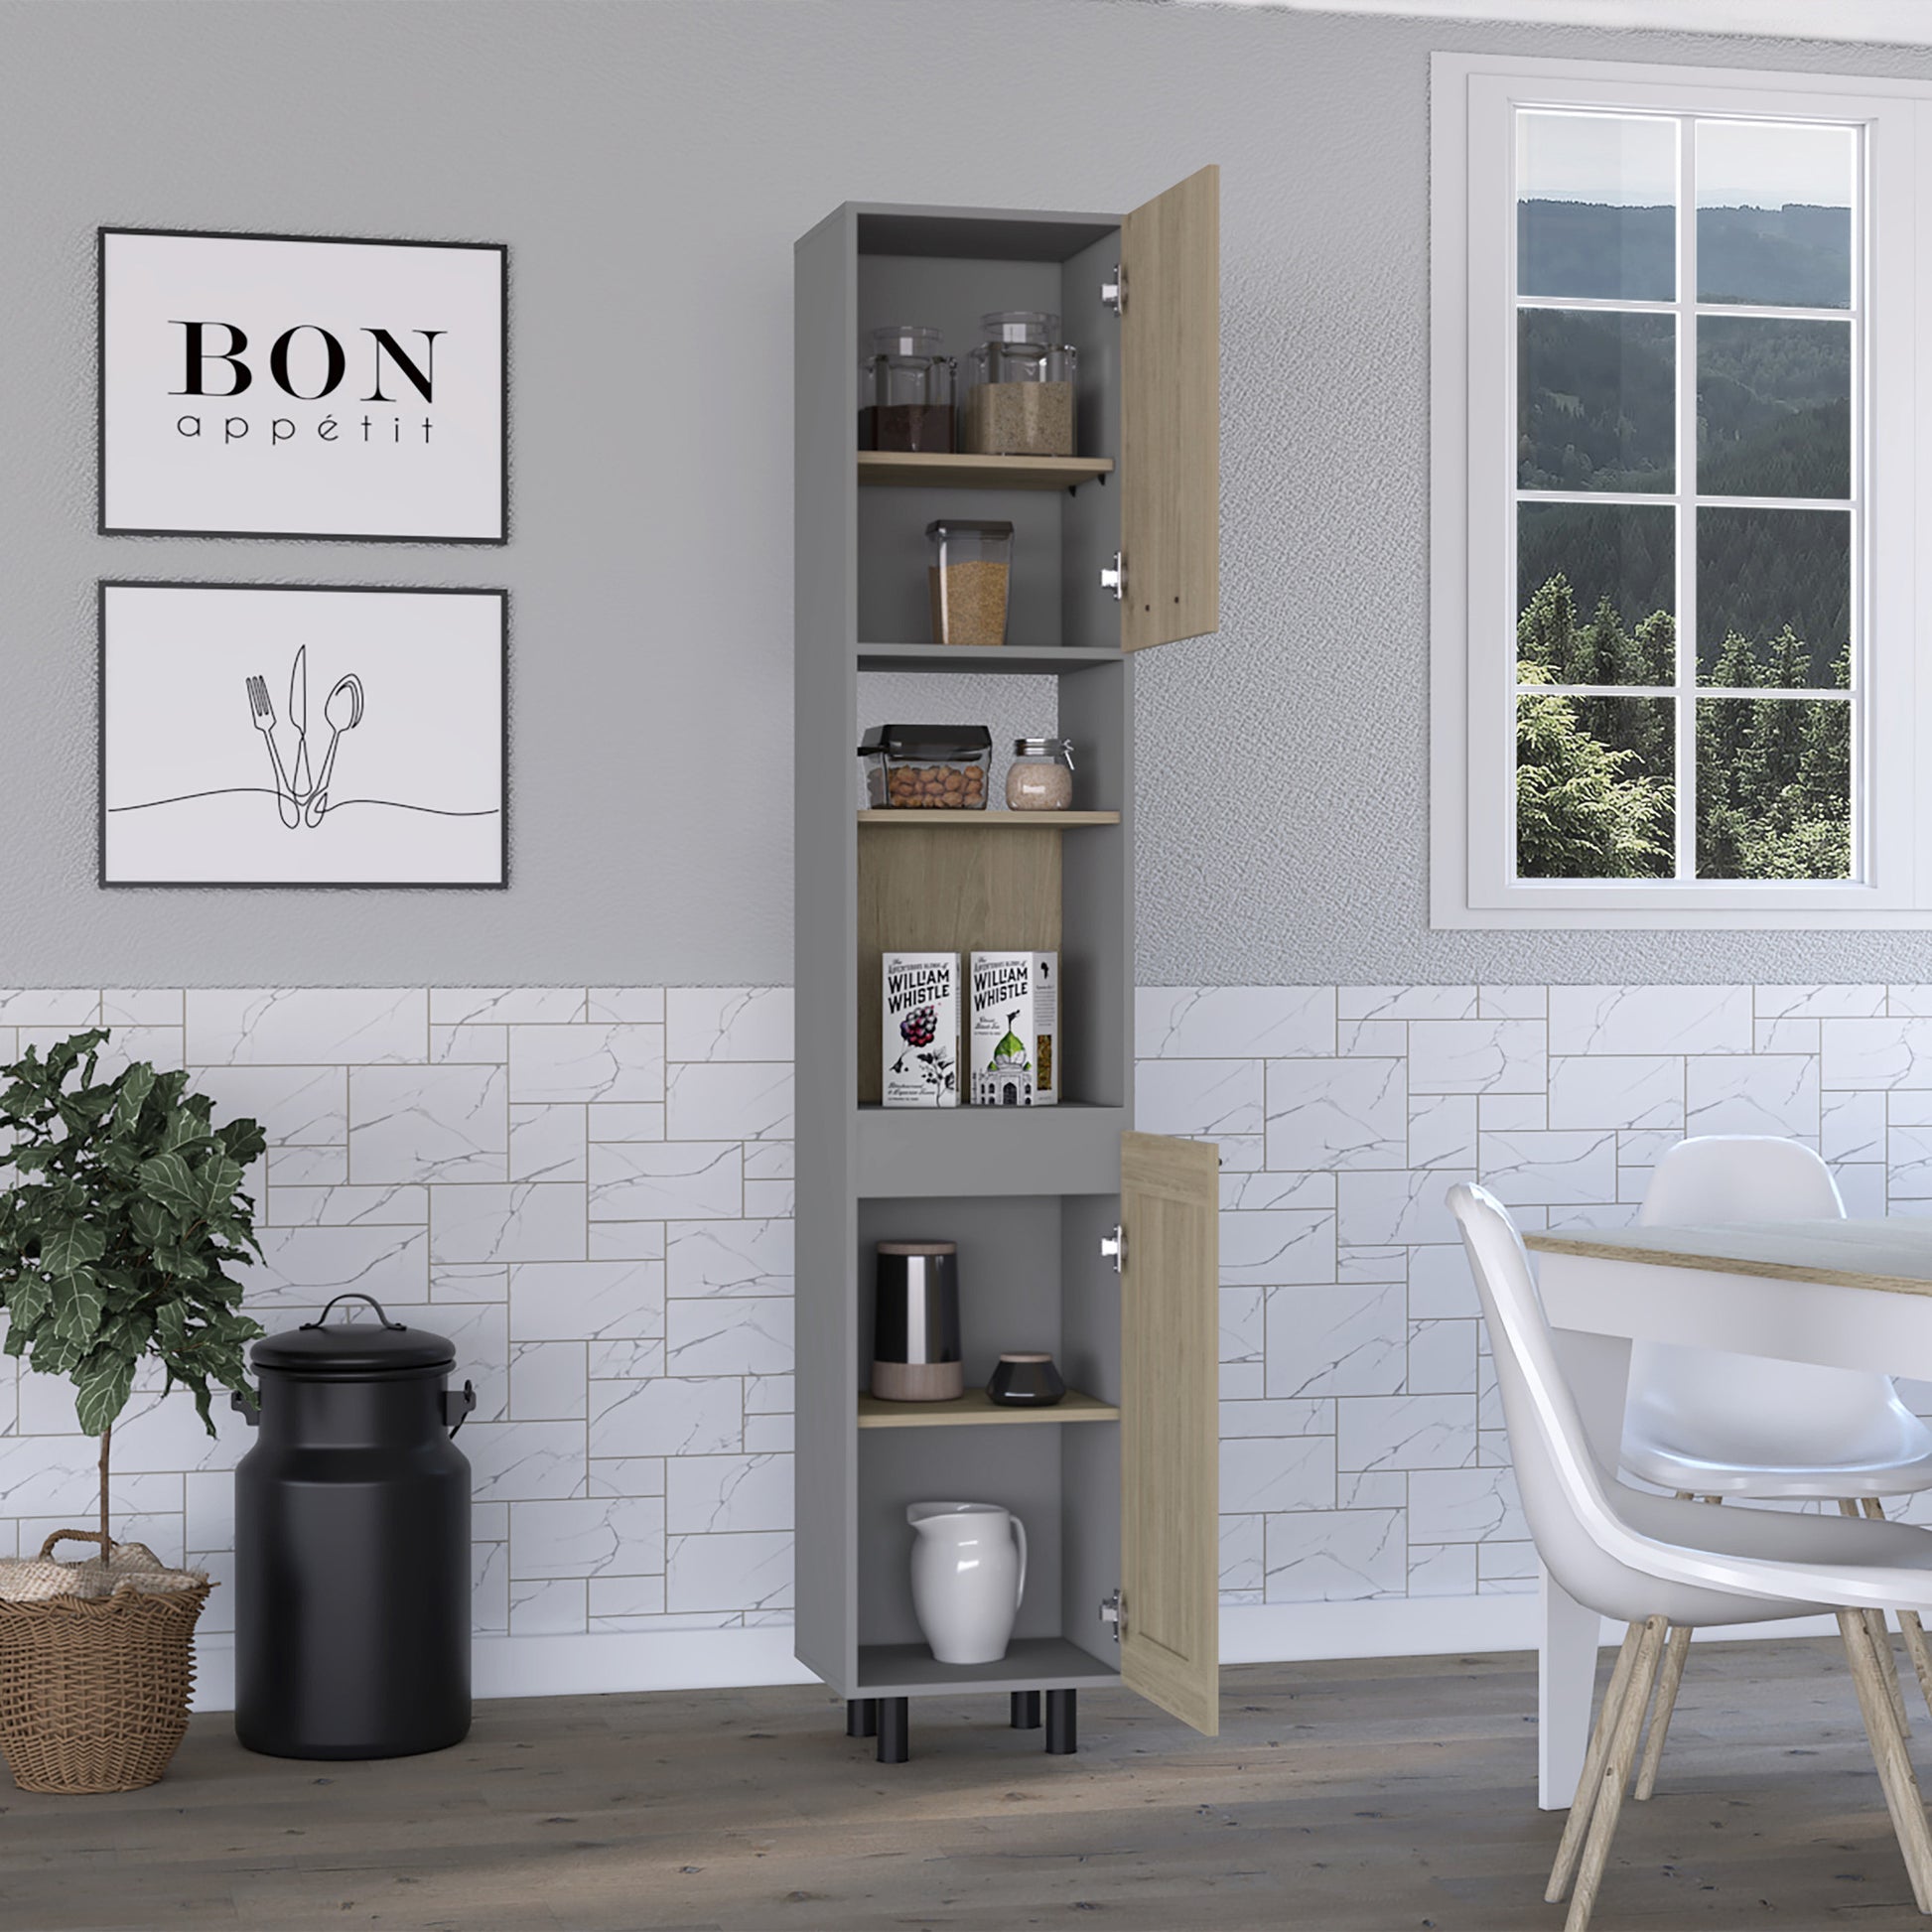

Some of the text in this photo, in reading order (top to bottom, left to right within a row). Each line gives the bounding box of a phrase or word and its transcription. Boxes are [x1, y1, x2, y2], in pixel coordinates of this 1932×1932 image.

[168, 321, 448, 404] BON
[177, 414, 433, 445] appétit
[888, 969, 949, 994] WILLIAM
[974, 967, 1028, 993] WILLIAM
[888, 984, 950, 1014] WHISTLE
[974, 982, 1028, 1012] WHISTLE
